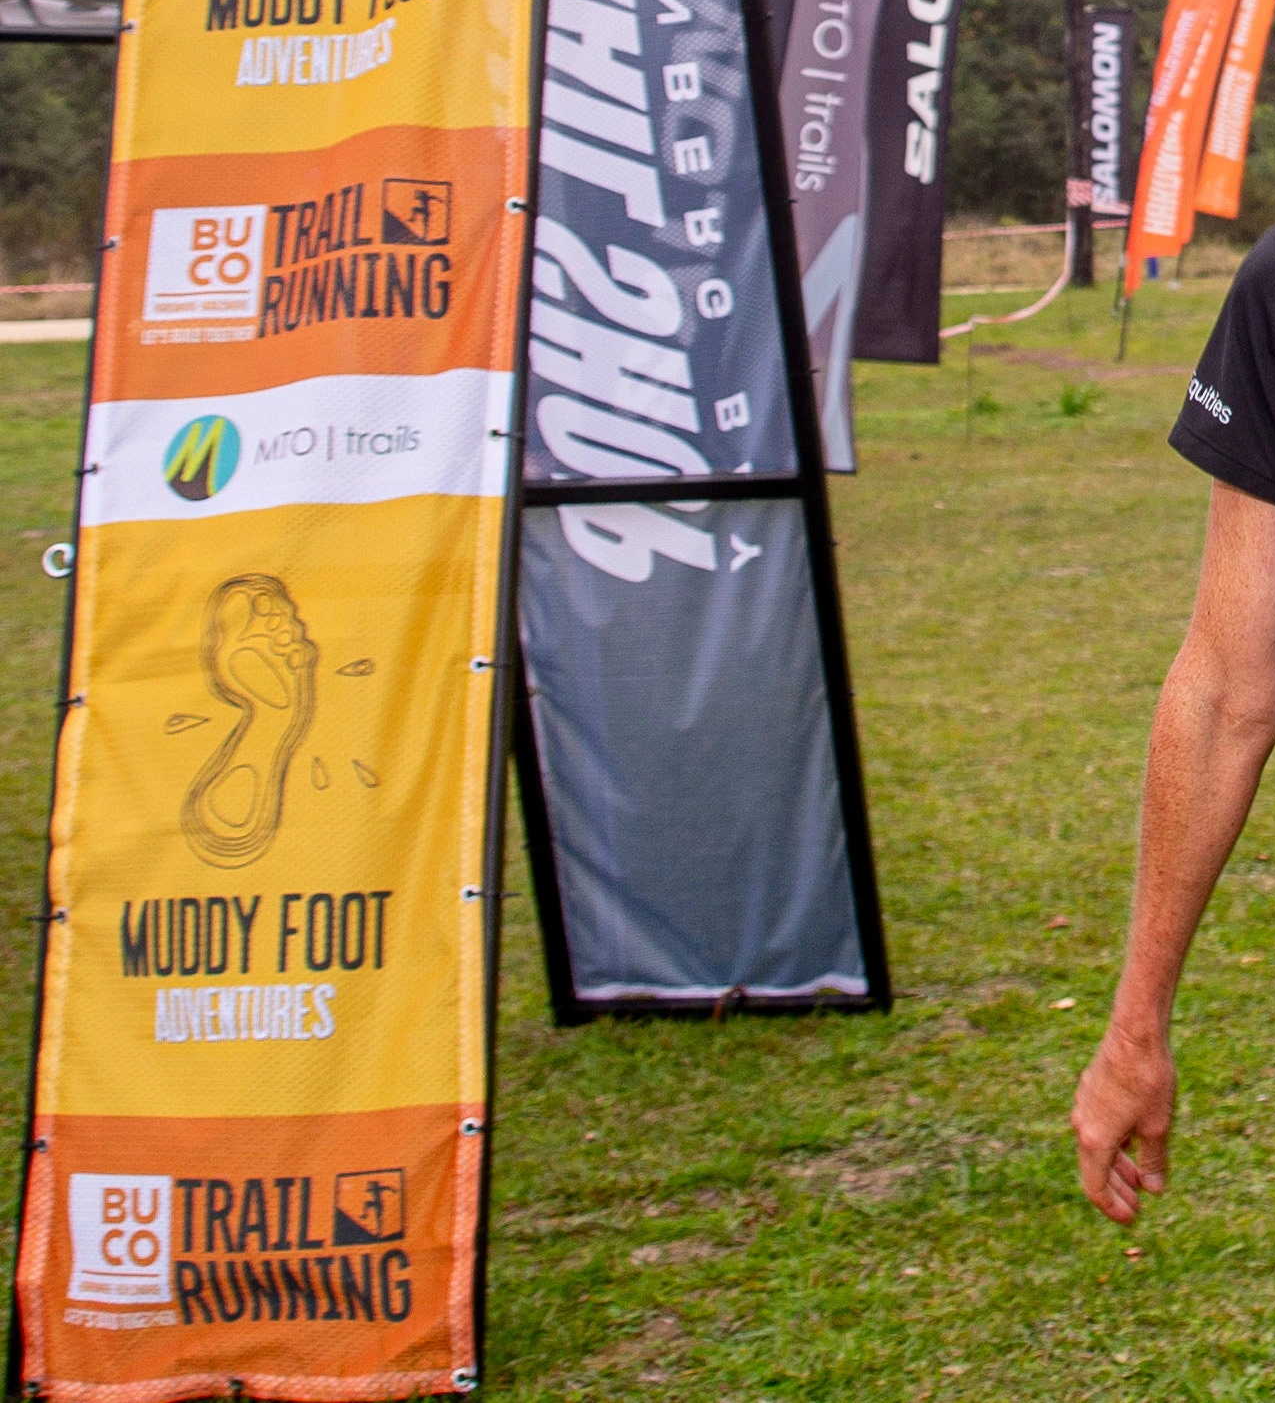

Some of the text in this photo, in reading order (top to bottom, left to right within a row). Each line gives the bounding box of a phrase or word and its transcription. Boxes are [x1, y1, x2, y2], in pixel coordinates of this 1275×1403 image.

[794, 91, 839, 194] trails
[191, 215, 254, 251] BU
[270, 182, 374, 268] TRAIL
[188, 251, 254, 287] CO
[257, 251, 453, 338] RUNNING
[1188, 370, 1233, 425] quities
[252, 425, 422, 466] MTO trails
[120, 890, 393, 978] MUDDY FOOT
[154, 983, 338, 1044] ADVENTURES
[103, 1187, 161, 1224] BU
[175, 1176, 326, 1255] TRAIL
[102, 1228, 161, 1266] CO
[173, 1249, 413, 1326] RUNNING
